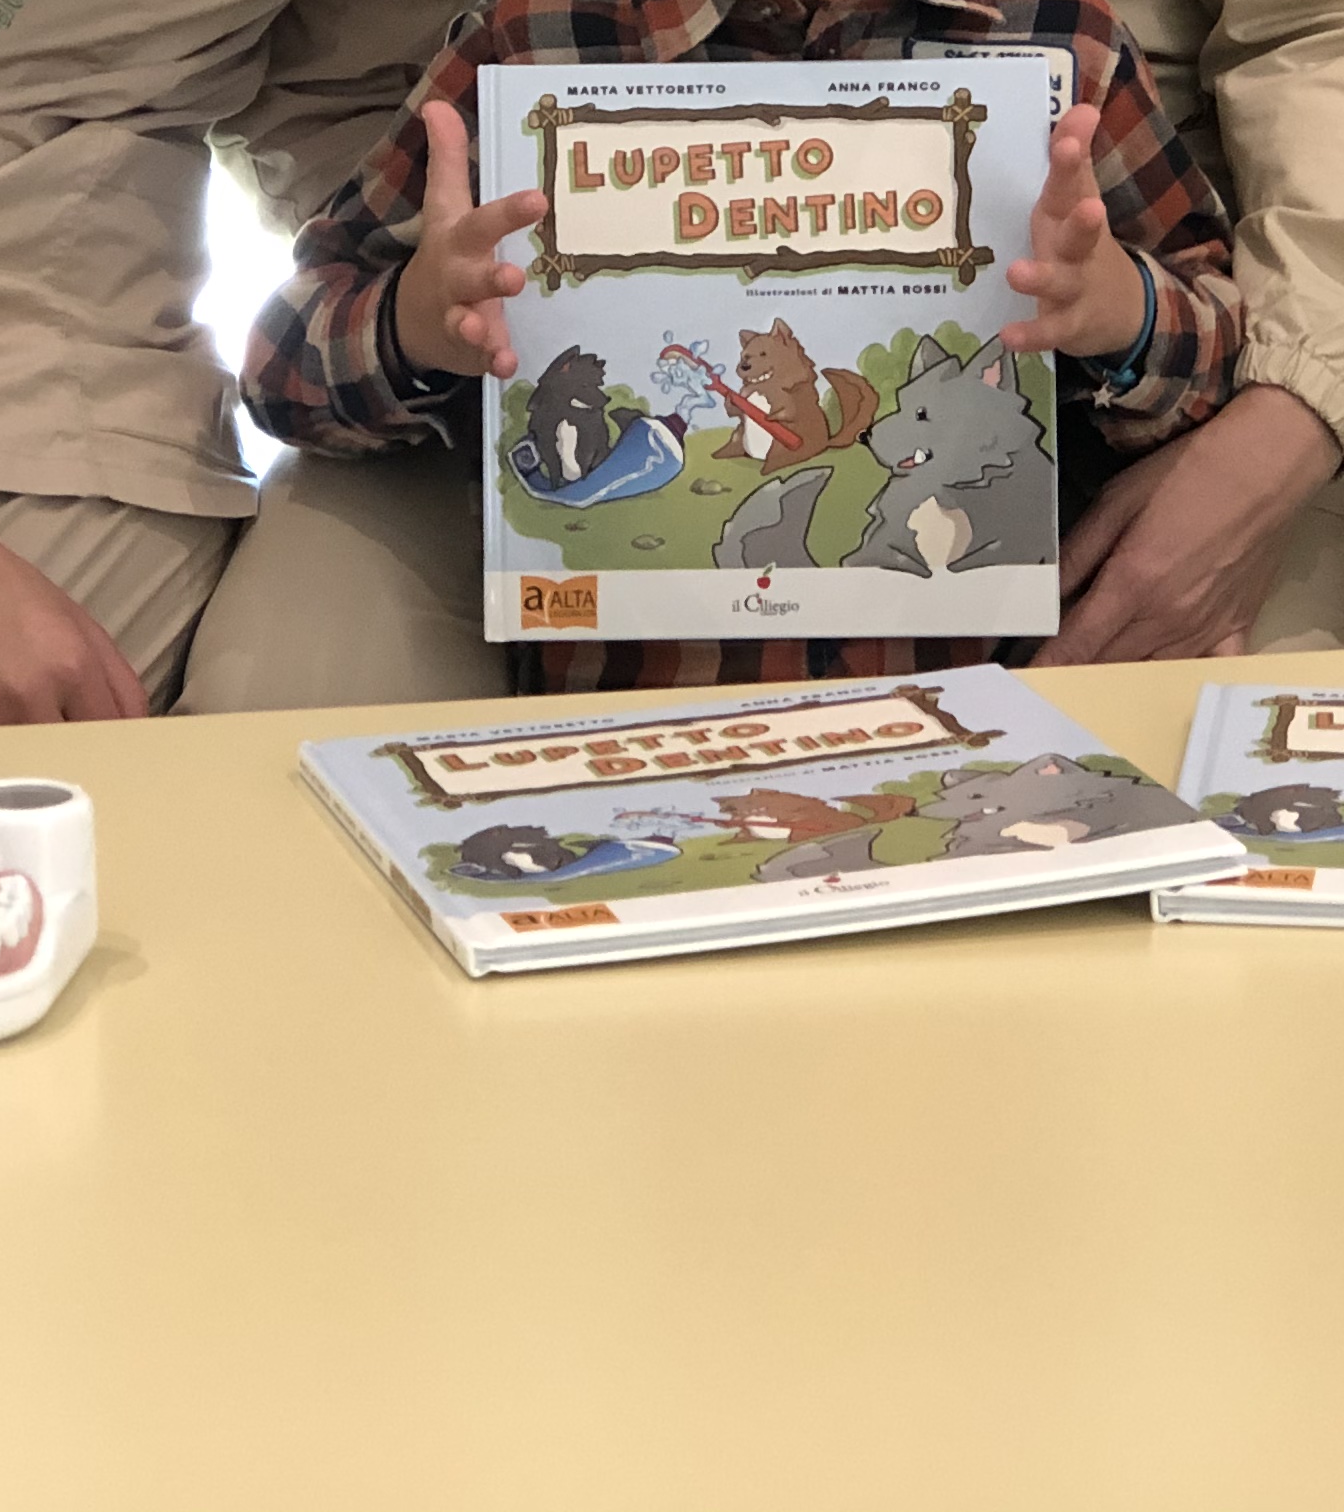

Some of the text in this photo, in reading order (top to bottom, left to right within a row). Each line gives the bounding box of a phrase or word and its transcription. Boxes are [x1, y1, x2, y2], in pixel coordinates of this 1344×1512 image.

[567, 84, 726, 96] MARTA VETTORETTO
[828, 81, 941, 92] ANNA FRANCO
[570, 137, 834, 191] LUPETTO
[675, 188, 944, 242] DENTINO
[838, 285, 896, 295] MATTIA
[903, 284, 947, 294] ROSSI
[550, 590, 597, 608] ALTA
[436, 723, 770, 772] LUPETTO
[587, 721, 924, 777] DENTINO
